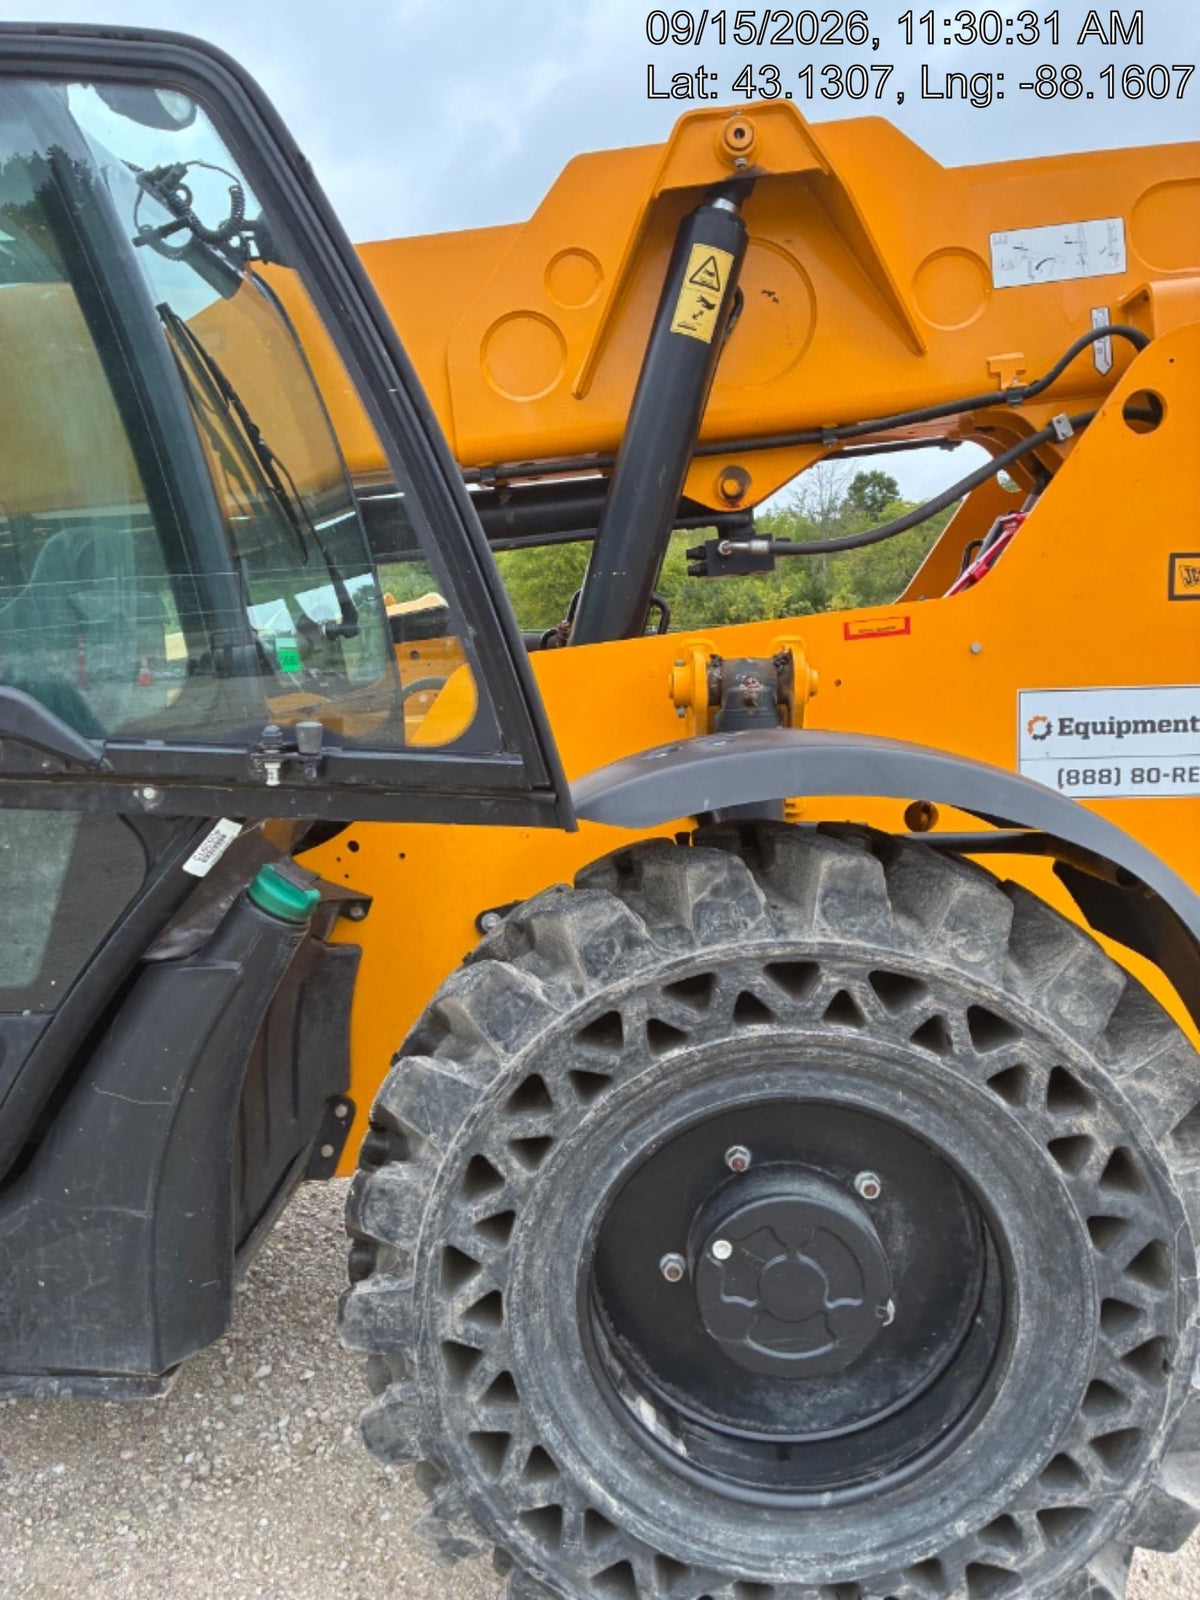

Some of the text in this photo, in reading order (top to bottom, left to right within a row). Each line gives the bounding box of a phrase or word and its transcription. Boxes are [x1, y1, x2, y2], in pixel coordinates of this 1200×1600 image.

[1057, 715, 1200, 740] Equipment
[1057, 766, 1200, 790] (888) 80-RE
